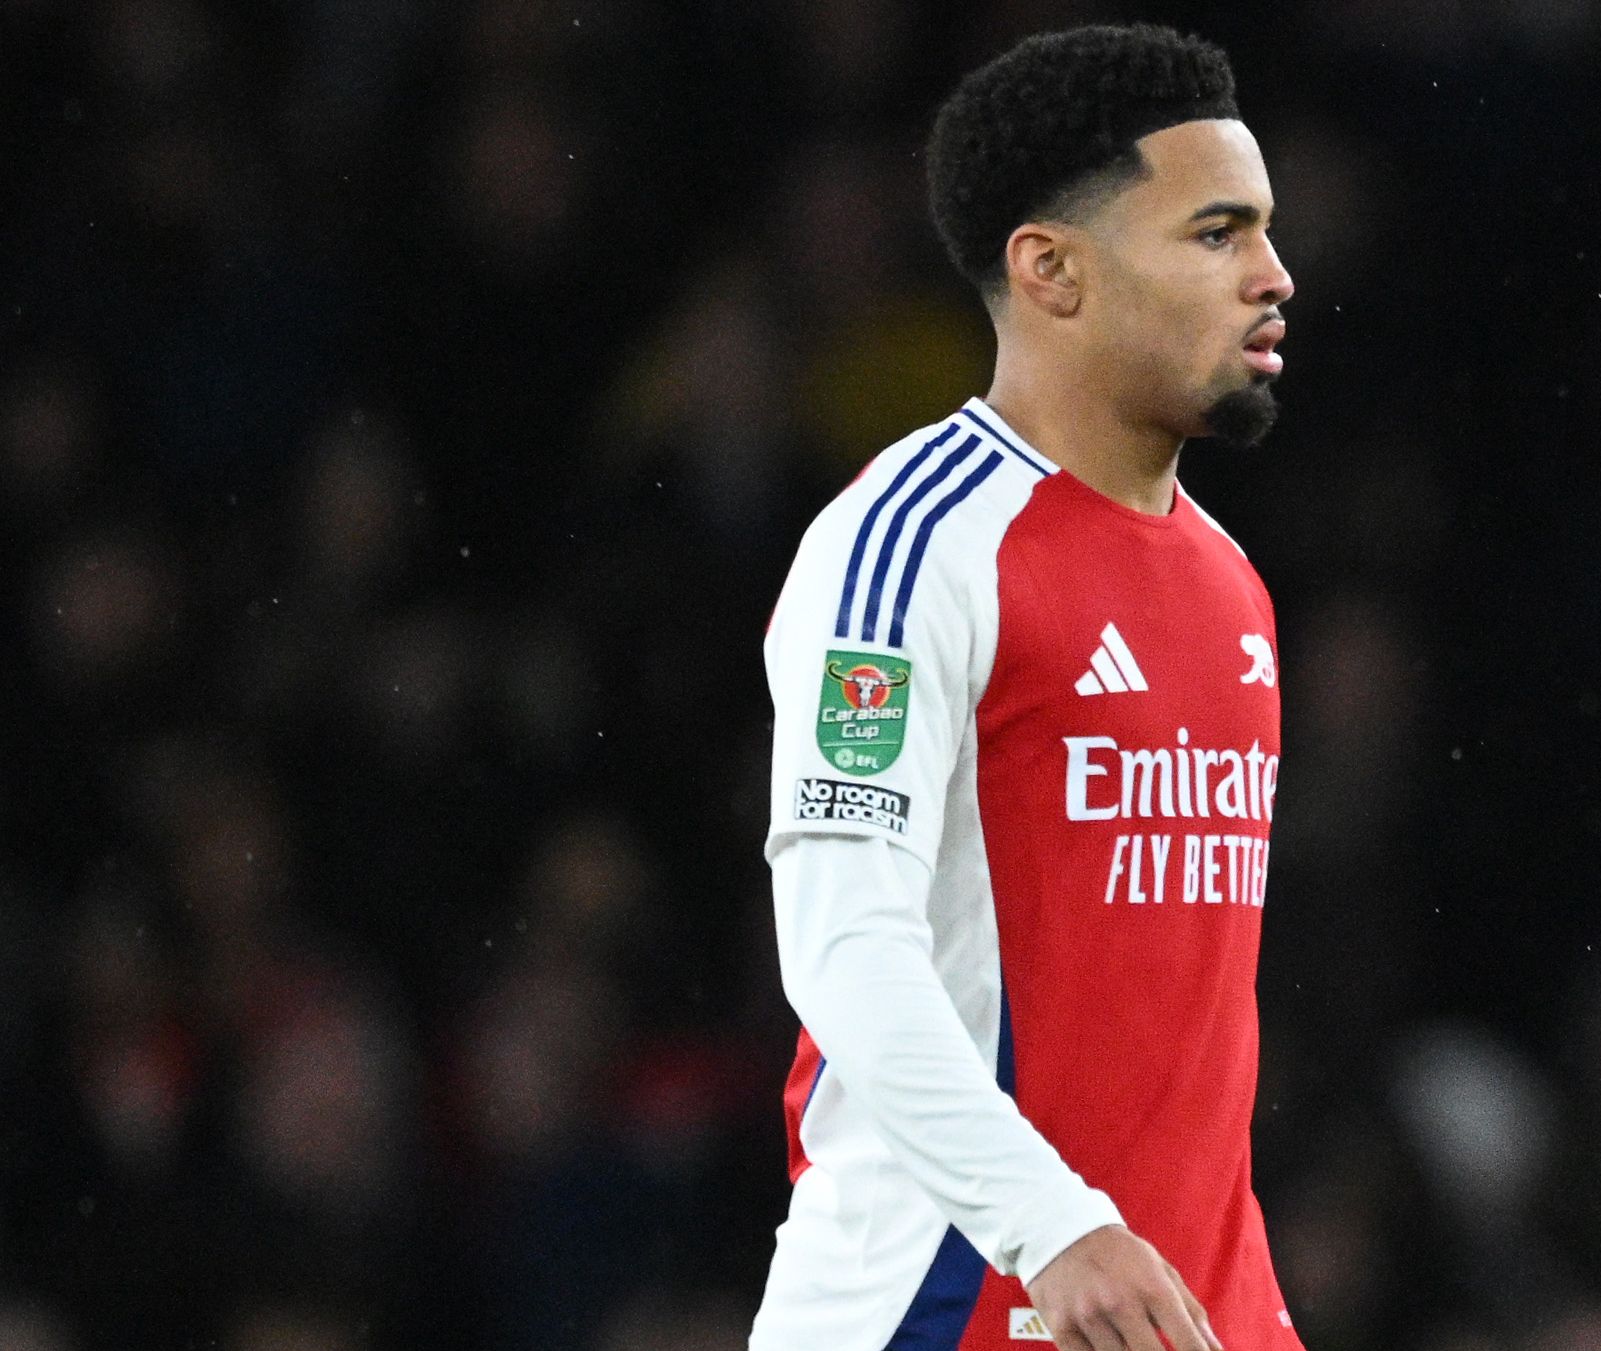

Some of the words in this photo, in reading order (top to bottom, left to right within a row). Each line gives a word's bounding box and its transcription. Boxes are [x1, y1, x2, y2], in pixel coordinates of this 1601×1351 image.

[822, 706, 904, 723] Carabao
[841, 723, 880, 741] Cup
[856, 754, 880, 770] EFL
[796, 779, 833, 801] No
[836, 785, 901, 814] room
[833, 802, 908, 835] racism
[1104, 834, 1171, 904] FLY
